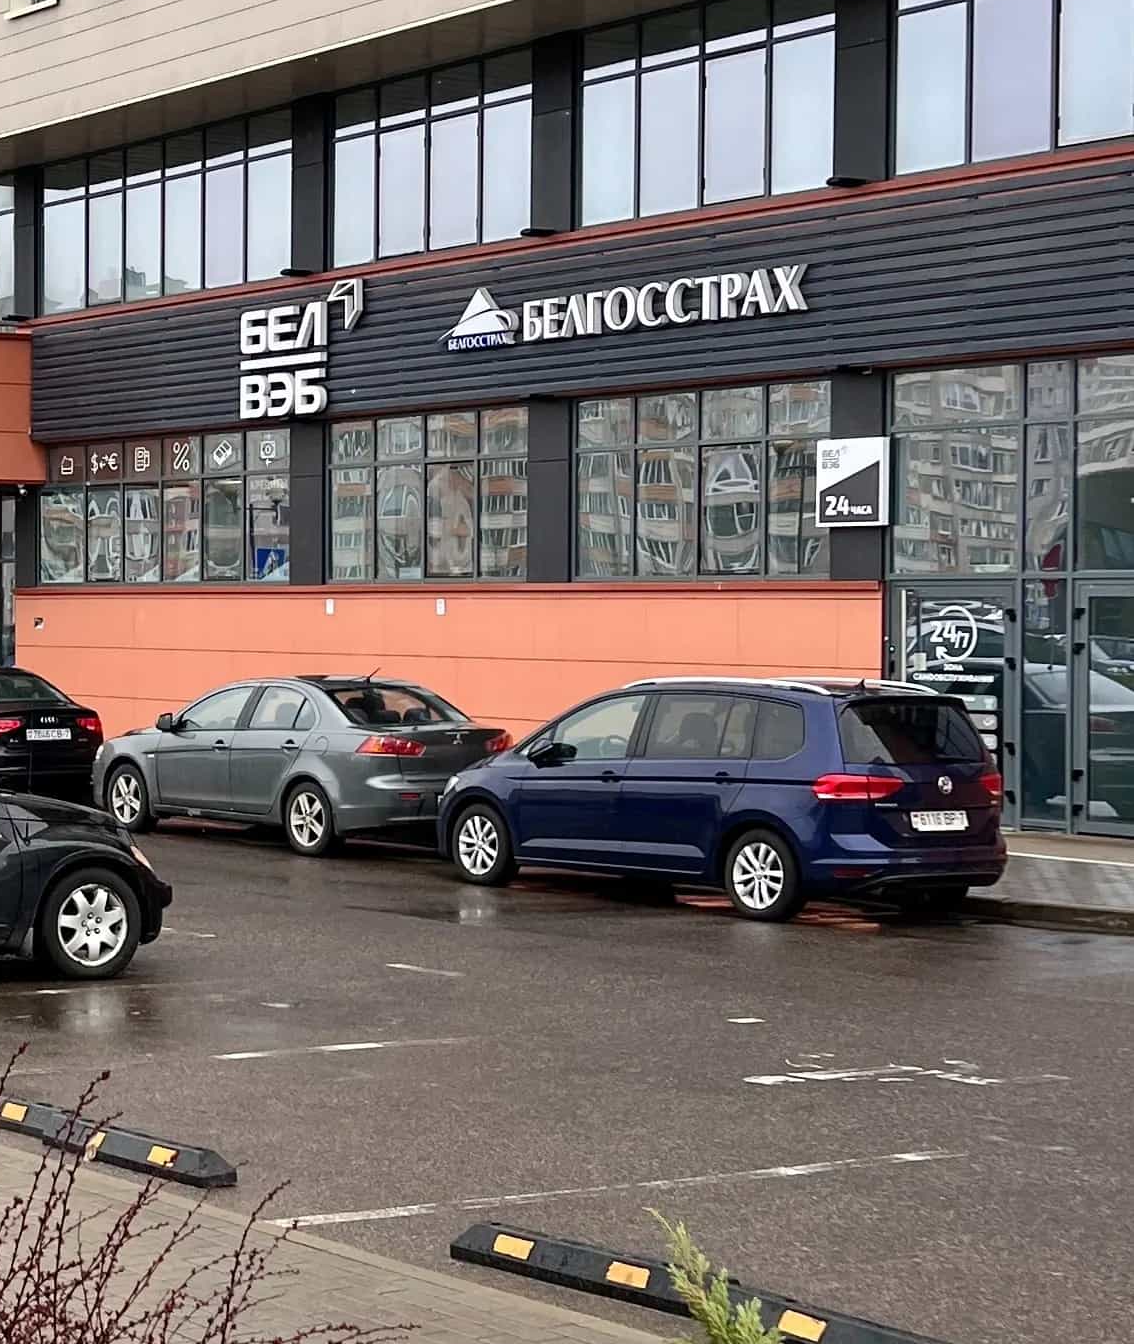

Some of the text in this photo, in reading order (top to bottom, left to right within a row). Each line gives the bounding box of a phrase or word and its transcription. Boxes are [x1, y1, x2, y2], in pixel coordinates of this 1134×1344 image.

[522, 264, 808, 343] БЕЛГОССТРАХ
[240, 301, 327, 354] БЕЛ
[447, 331, 510, 351] БЕЛГОССТРАХ
[240, 367, 327, 419] ВЭБ
[825, 495, 849, 516] 24
[930, 621, 970, 649] 24/7
